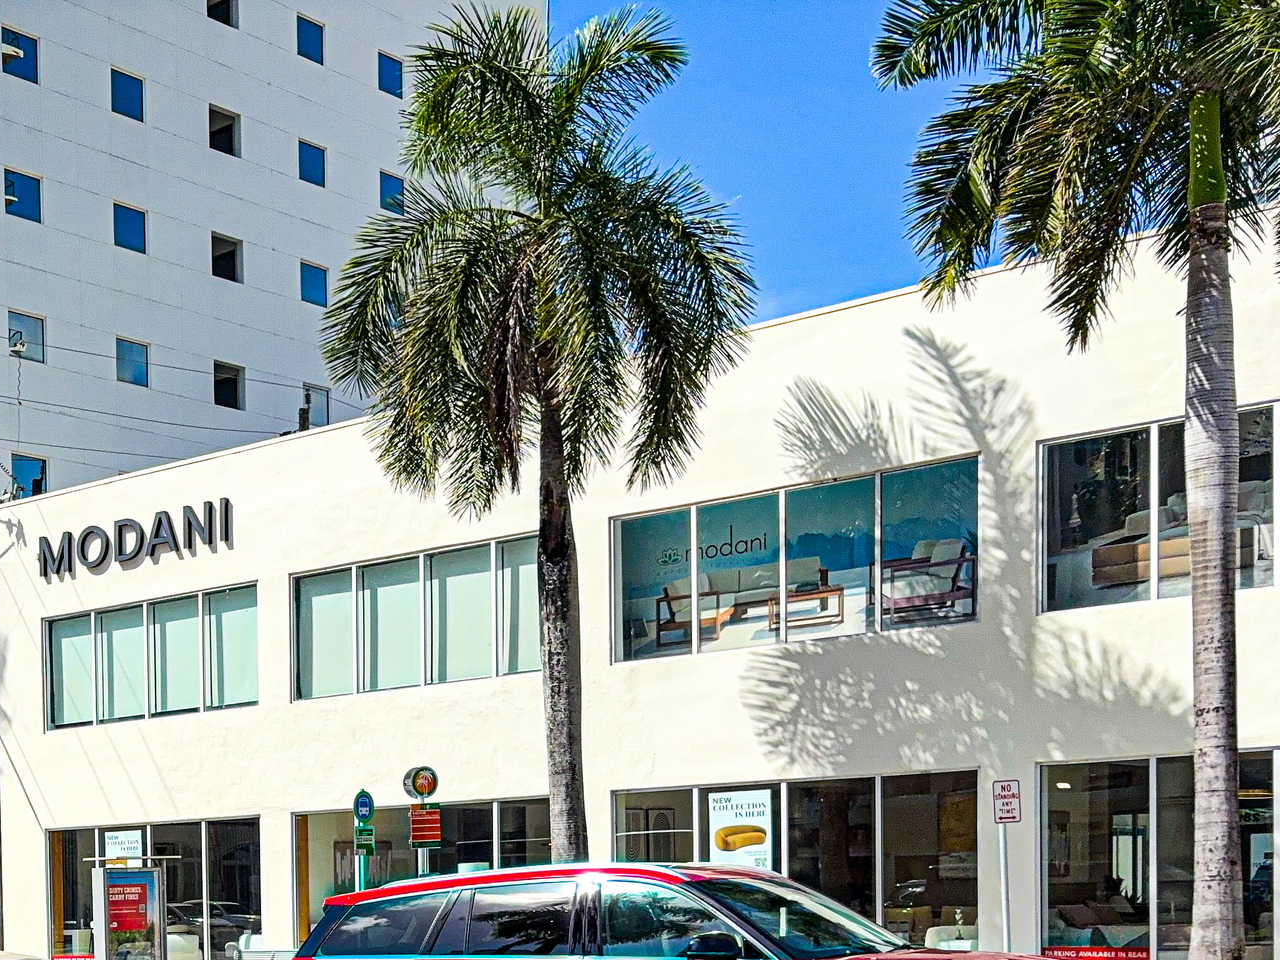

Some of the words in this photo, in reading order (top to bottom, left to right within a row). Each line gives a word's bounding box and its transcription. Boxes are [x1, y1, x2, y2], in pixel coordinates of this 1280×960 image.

[39, 497, 232, 580] MODANI
[685, 524, 767, 562] modani
[1000, 784, 1011, 792] NO
[713, 803, 767, 811] COLLECTION
[1078, 950, 1116, 958] AVAILABLE
